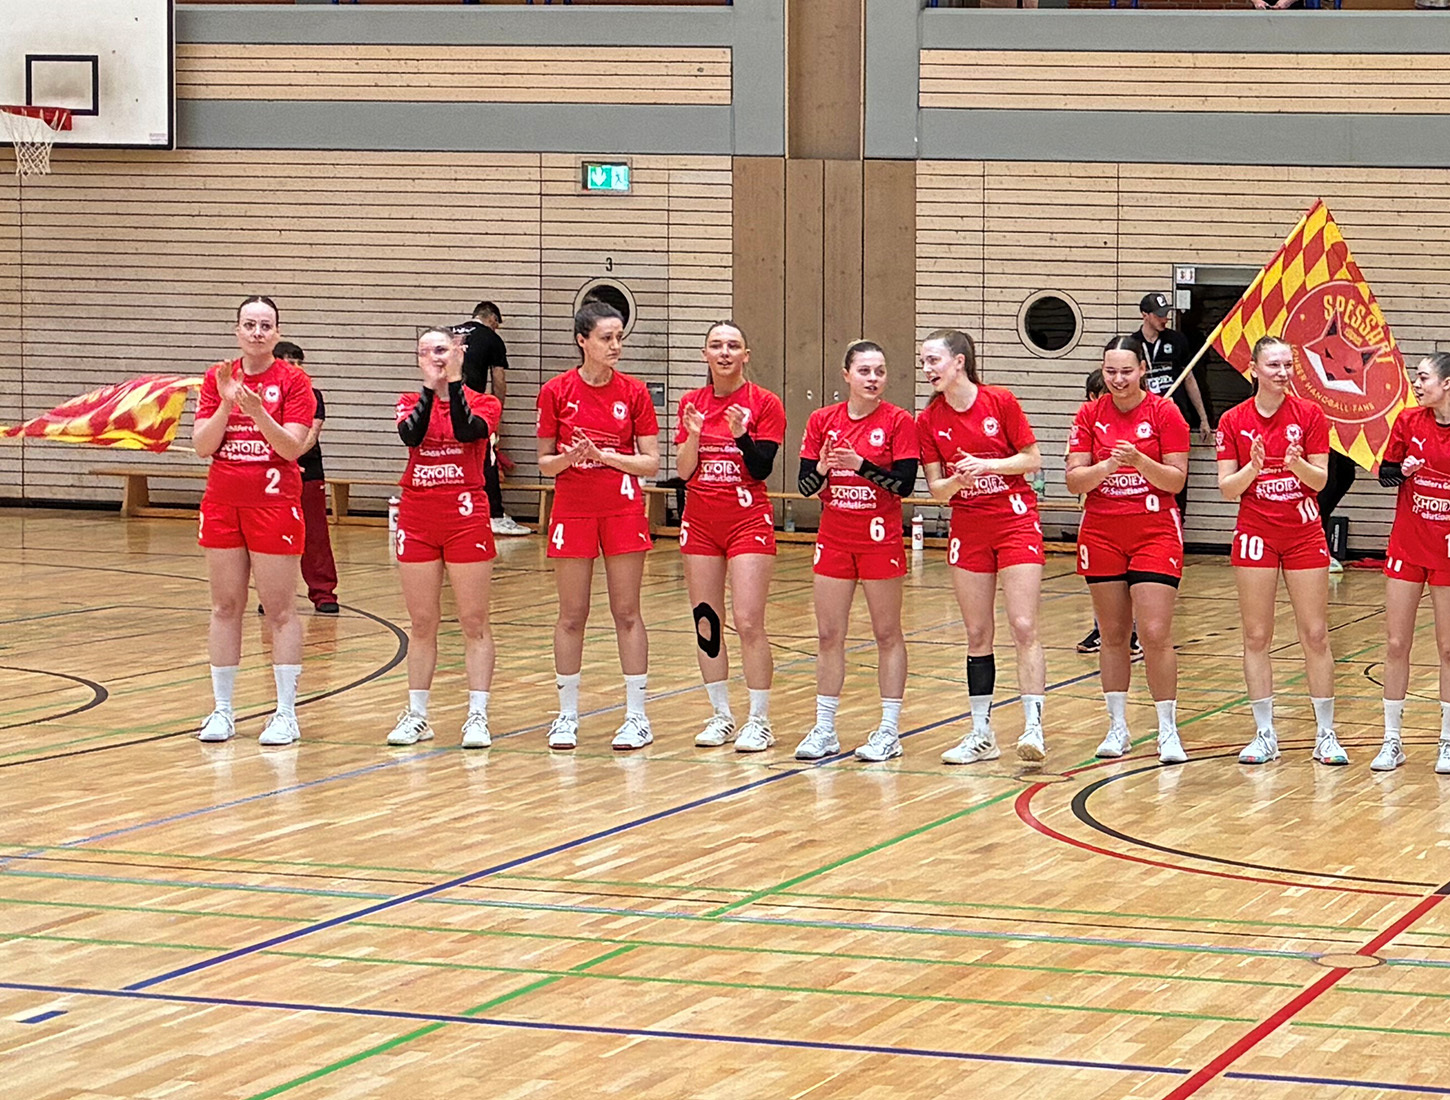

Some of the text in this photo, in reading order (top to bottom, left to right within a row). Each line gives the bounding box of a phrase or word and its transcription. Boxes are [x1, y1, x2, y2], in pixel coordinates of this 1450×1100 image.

[605, 257, 613, 272] 3
[1323, 294, 1395, 365] SPESSART
[1304, 382, 1349, 413] HANDBALL
[265, 468, 280, 494] 2
[413, 464, 464, 479] SCHOTEX
[621, 474, 634, 500] 4
[736, 486, 753, 508] 5
[830, 485, 876, 500] SCHOTEX
[458, 492, 473, 516] 3
[1009, 493, 1028, 515] 8
[1296, 497, 1319, 524] 10
[397, 529, 406, 556] 3
[552, 523, 565, 550] 4
[679, 521, 690, 546] 5
[870, 517, 885, 542] 6
[950, 538, 961, 564] 8
[1080, 544, 1089, 570] 9
[1239, 533, 1264, 561] 10
